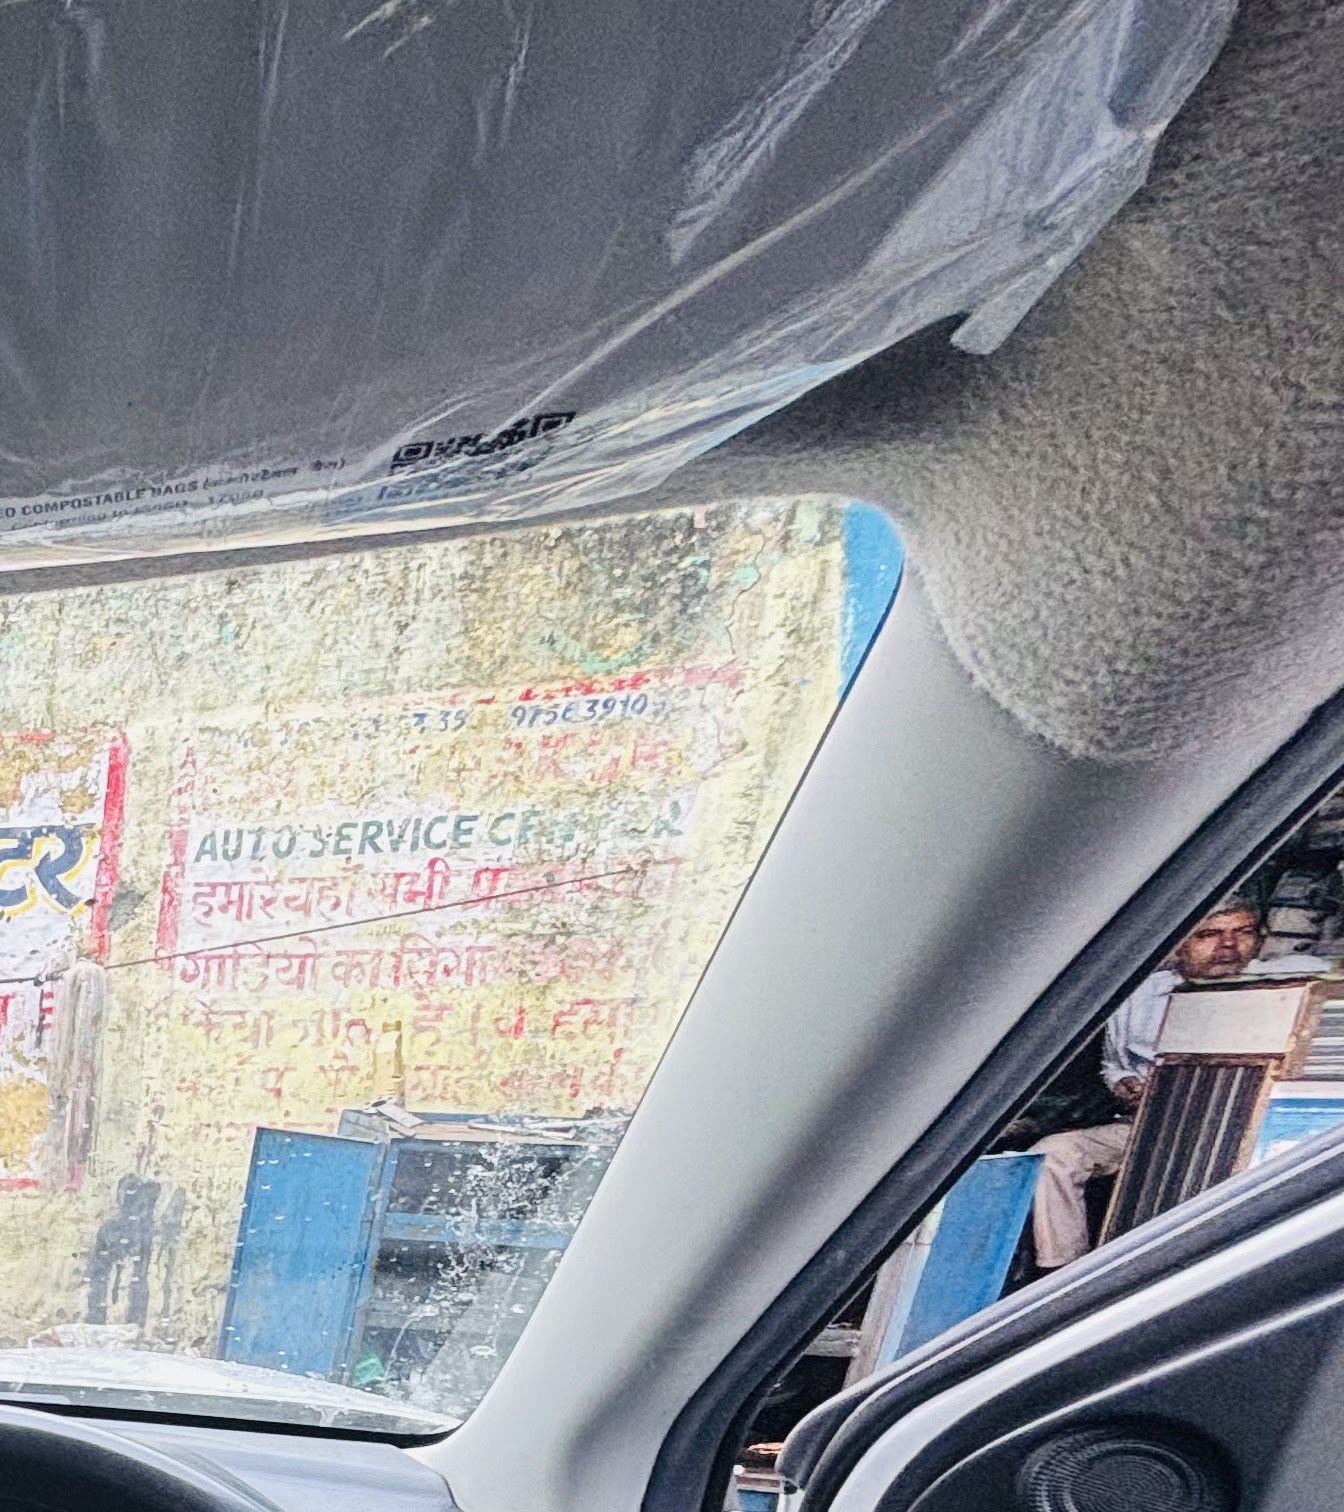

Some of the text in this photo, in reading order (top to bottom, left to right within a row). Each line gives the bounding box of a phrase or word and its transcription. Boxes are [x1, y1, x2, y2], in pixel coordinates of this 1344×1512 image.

[21, 487, 147, 516] COMPOSTABLE
[193, 825, 298, 862] AUTO
[308, 813, 479, 859] SERVICE
